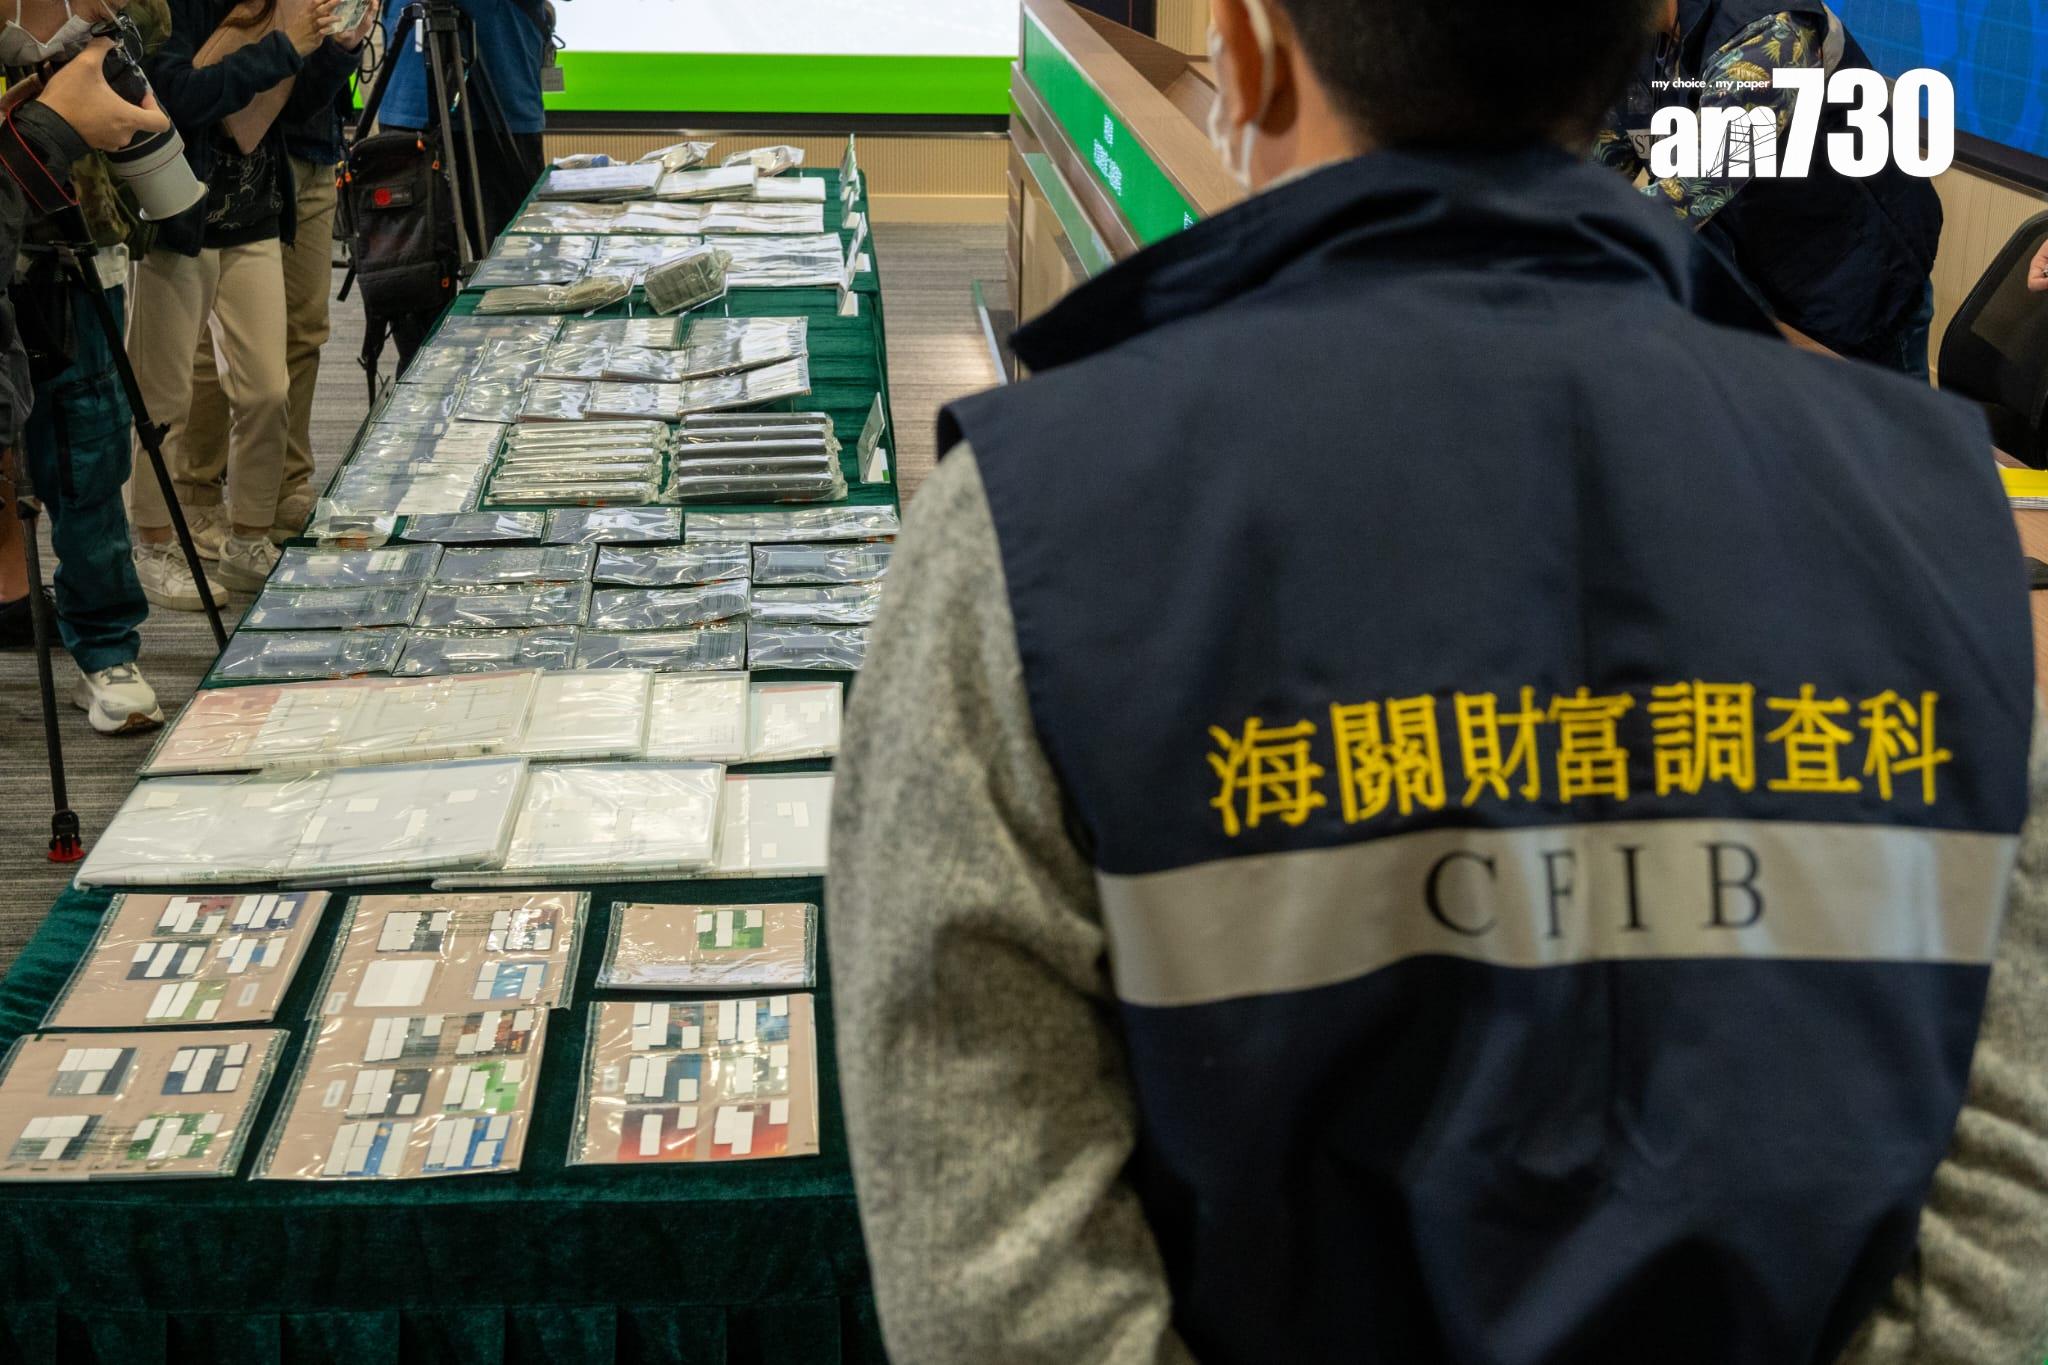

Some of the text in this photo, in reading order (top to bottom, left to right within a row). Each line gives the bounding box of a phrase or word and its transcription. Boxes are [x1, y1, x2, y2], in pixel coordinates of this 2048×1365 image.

[1207, 680, 1953, 836] 海關財富調查科
